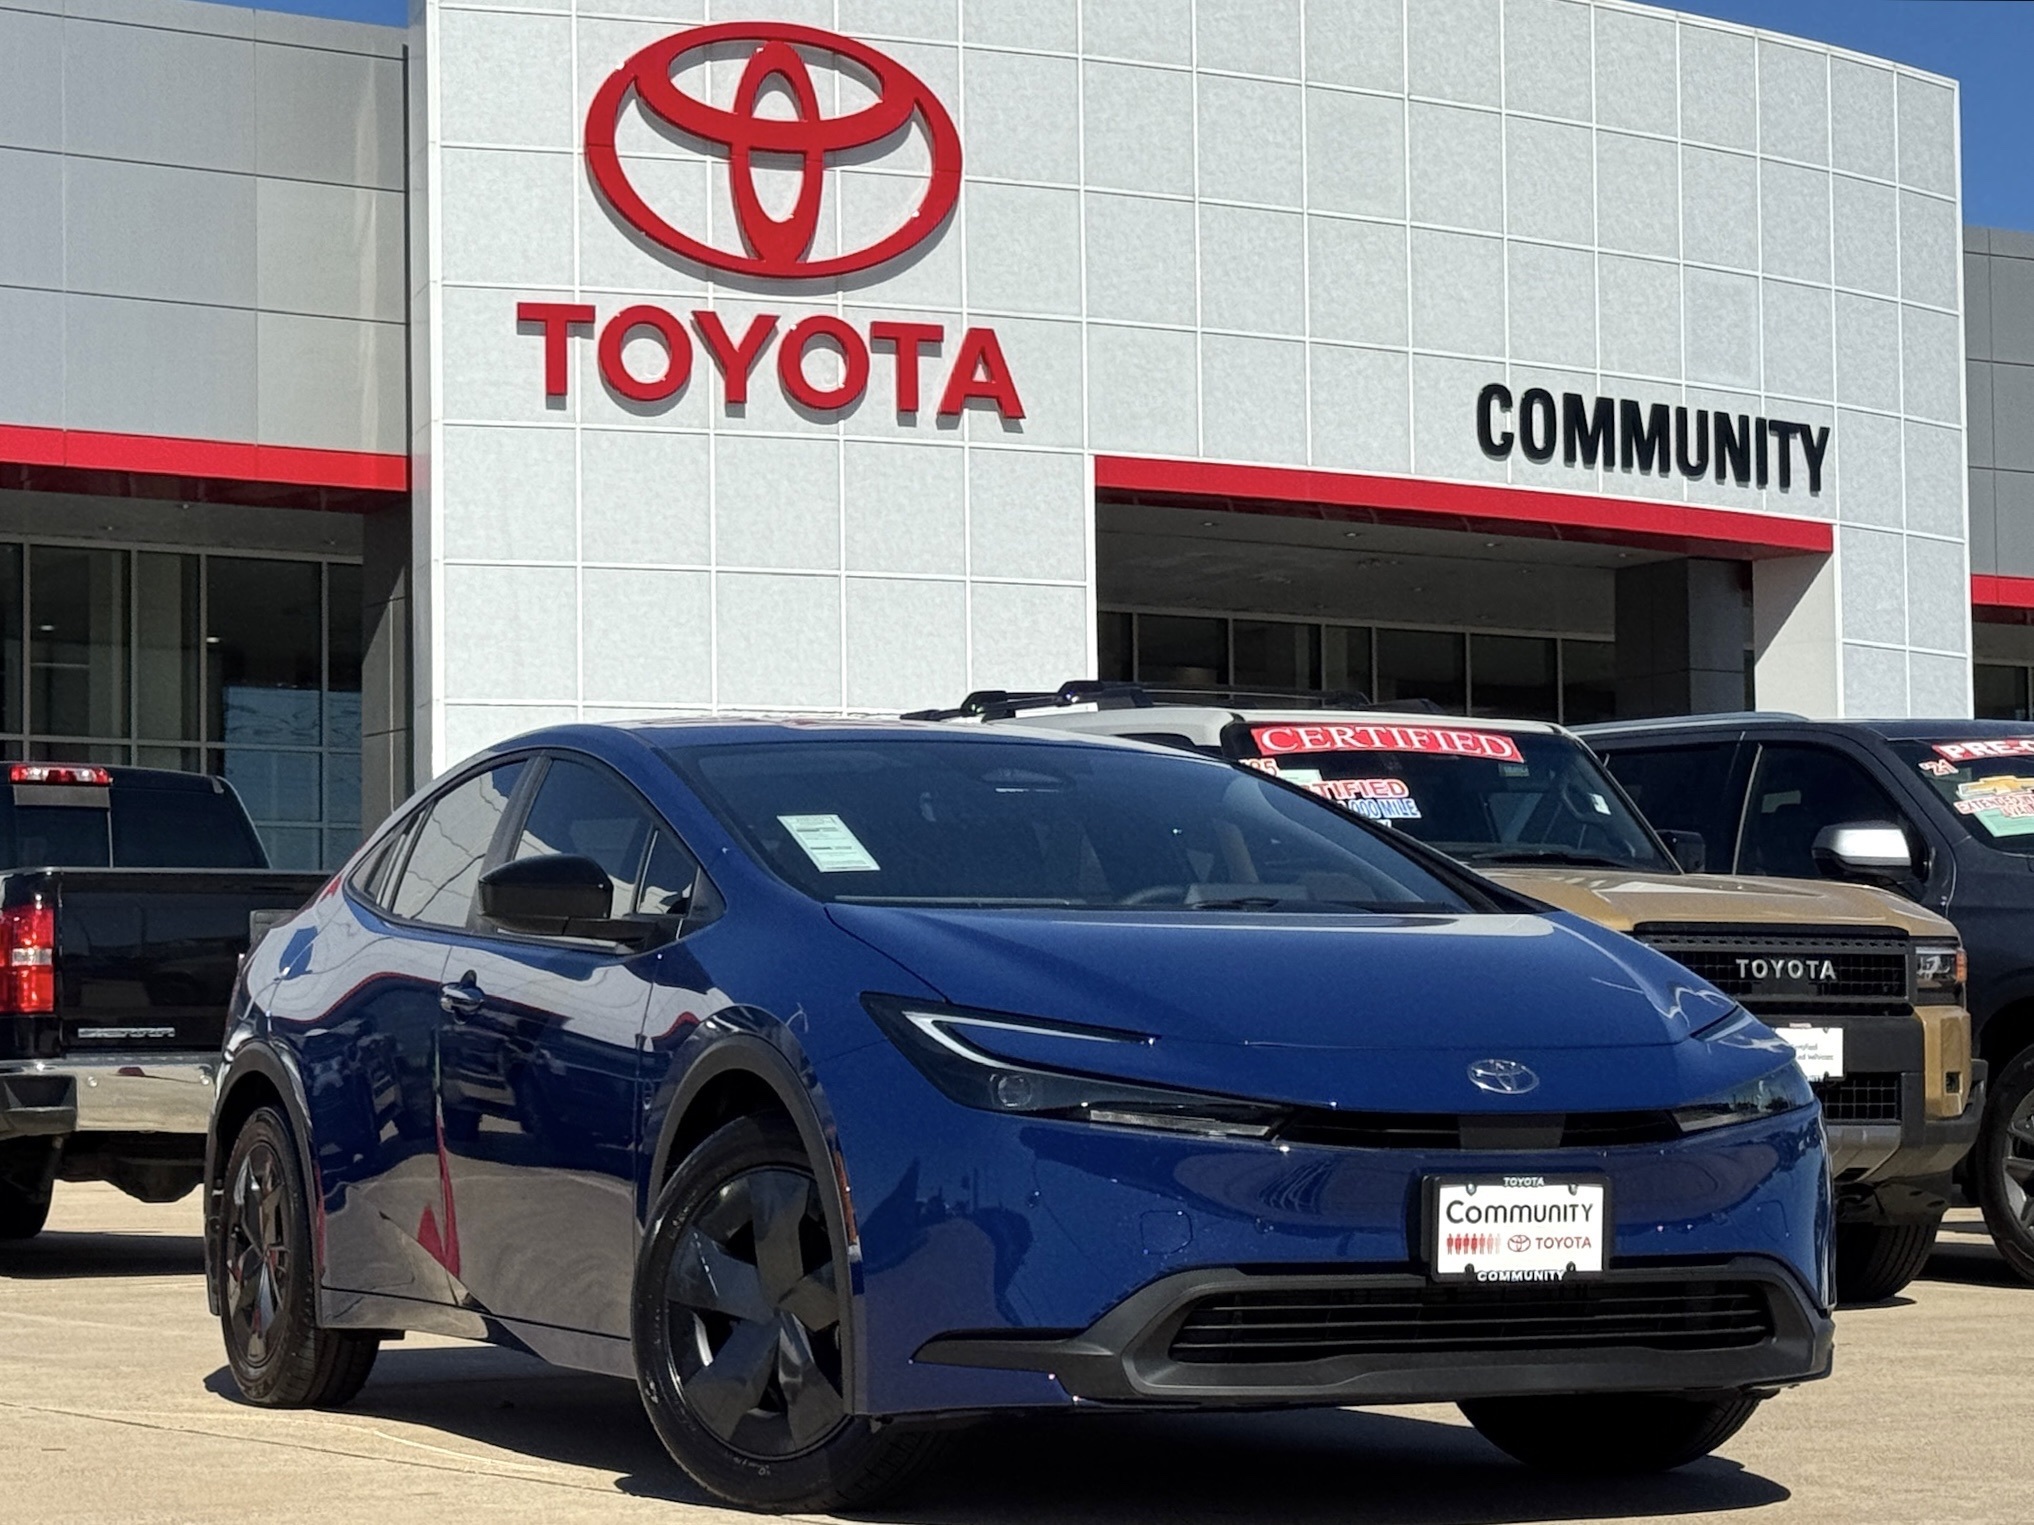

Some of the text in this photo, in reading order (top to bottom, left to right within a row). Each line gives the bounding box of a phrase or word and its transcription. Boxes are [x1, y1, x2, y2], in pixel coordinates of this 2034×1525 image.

[516, 301, 1026, 421] TOYOTA
[1476, 382, 1831, 493] COMMUNITY
[1261, 725, 1513, 759] CERTIFIED
[1735, 958, 1837, 980] TOYOTA
[1502, 1176, 1545, 1187] TOYOTA
[1536, 1236, 1592, 1249] TOYOTA
[1476, 1270, 1565, 1282] COMMUNITY
